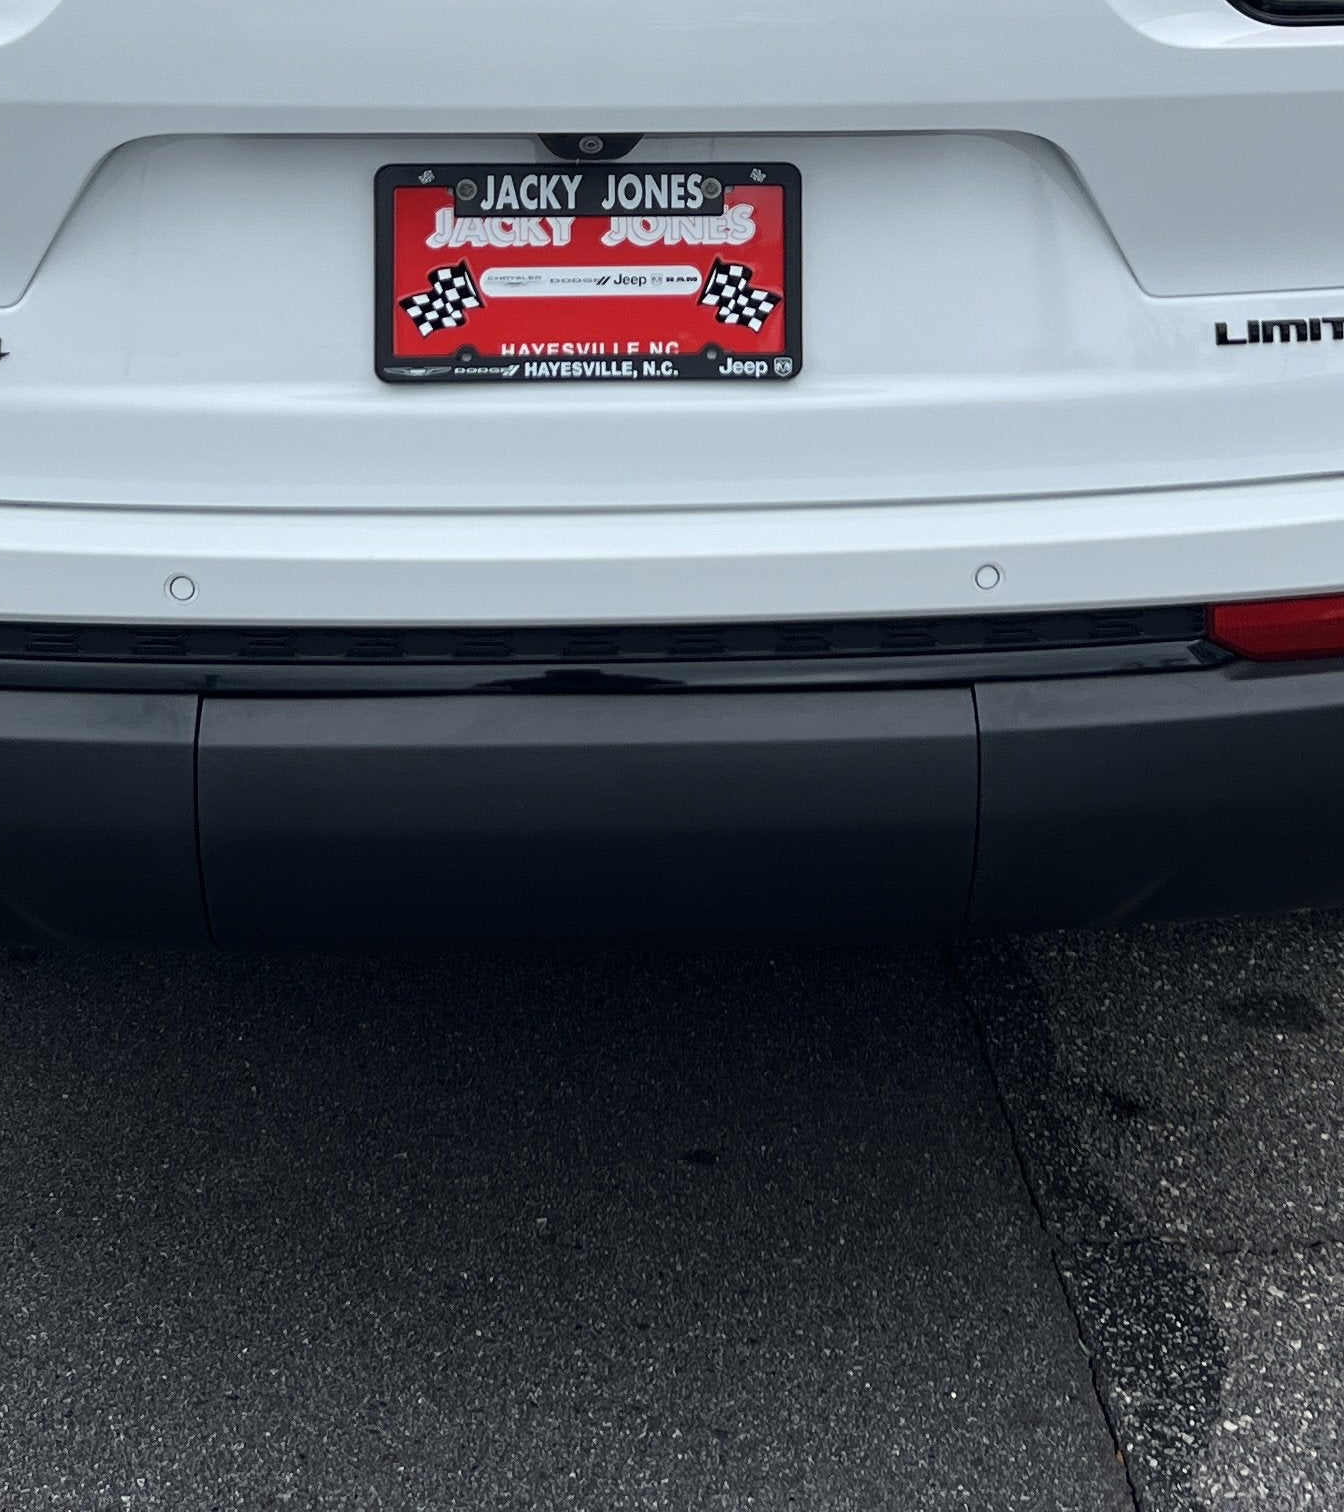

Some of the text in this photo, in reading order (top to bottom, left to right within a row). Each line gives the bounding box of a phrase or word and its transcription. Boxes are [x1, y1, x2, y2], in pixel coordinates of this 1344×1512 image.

[480, 173, 705, 211] JACKY JONES
[425, 203, 756, 249] JACKY JONES
[613, 273, 647, 287] Jeep
[524, 360, 639, 378] HAYESVILLE,
[642, 360, 680, 377] N.C.
[718, 356, 769, 378] Jeep
